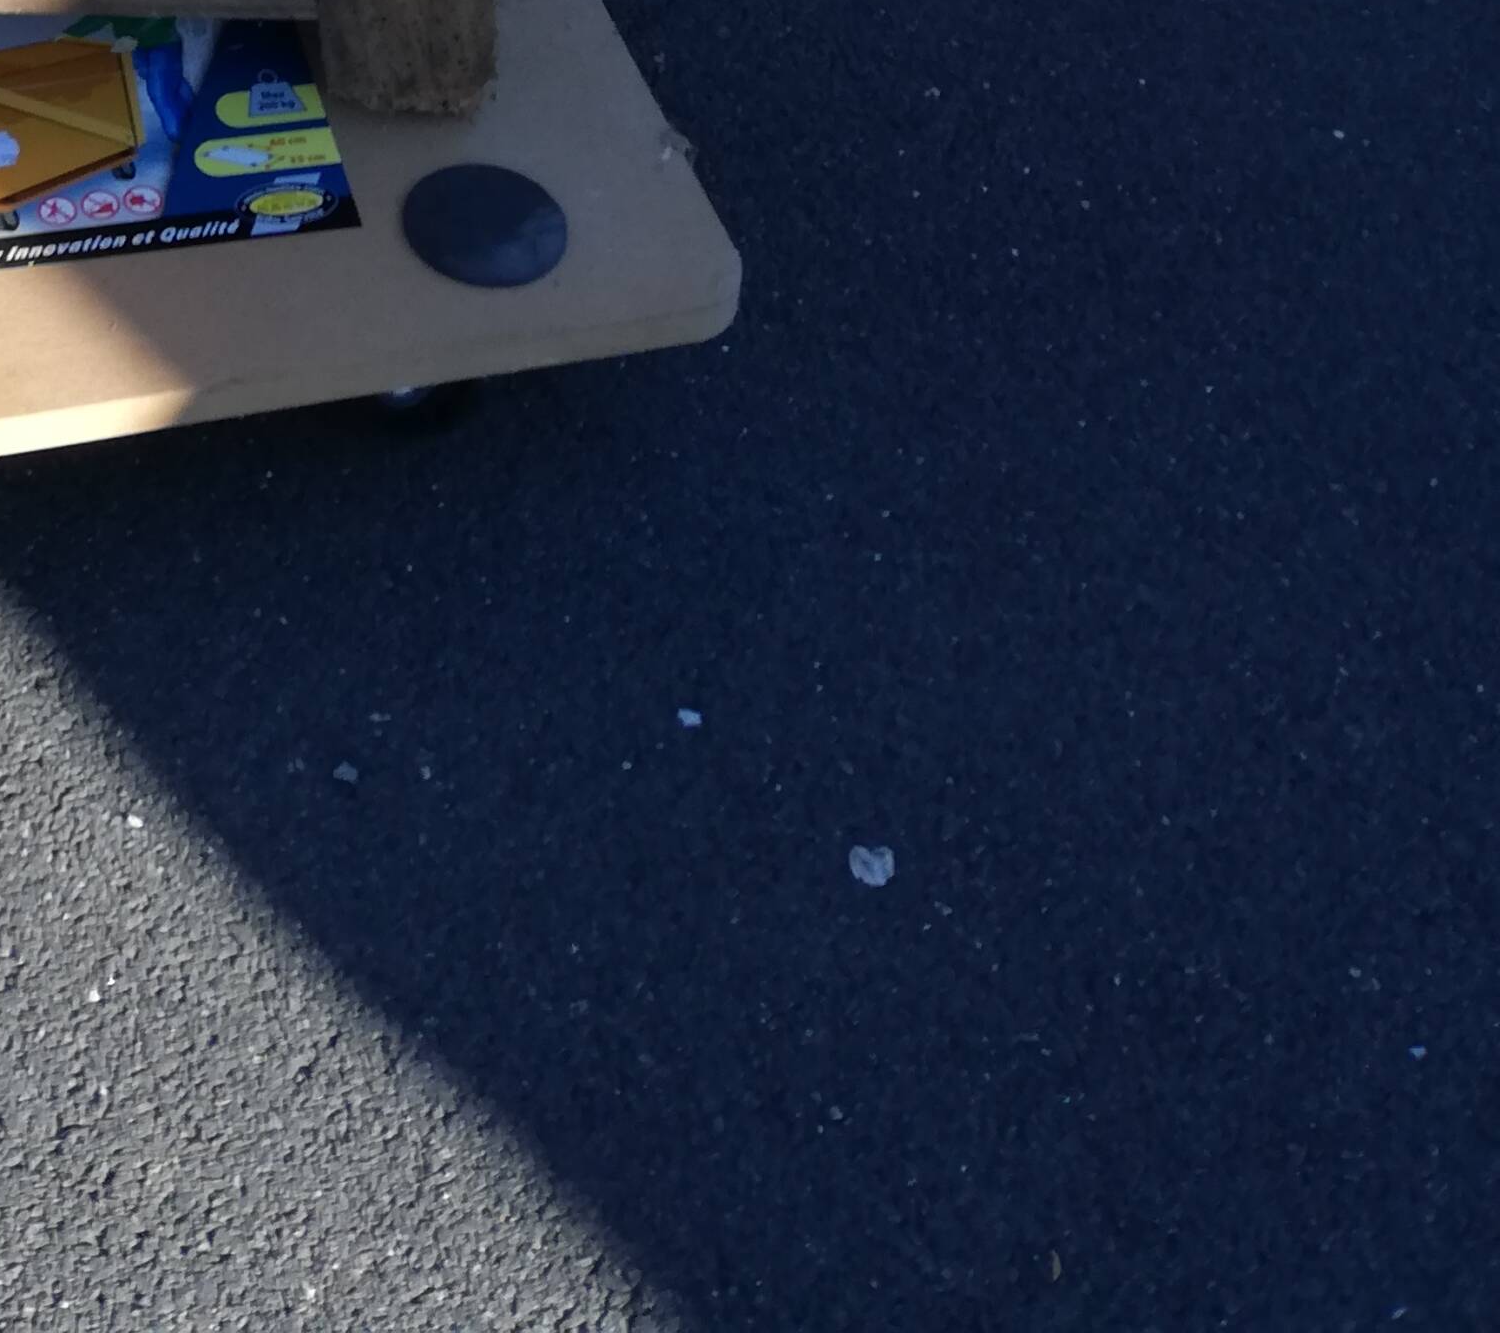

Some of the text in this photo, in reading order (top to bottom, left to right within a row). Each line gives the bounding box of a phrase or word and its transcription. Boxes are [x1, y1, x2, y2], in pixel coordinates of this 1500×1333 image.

[6, 234, 127, 263] Innovation
[131, 230, 156, 247] et
[158, 218, 241, 243] Qualité
